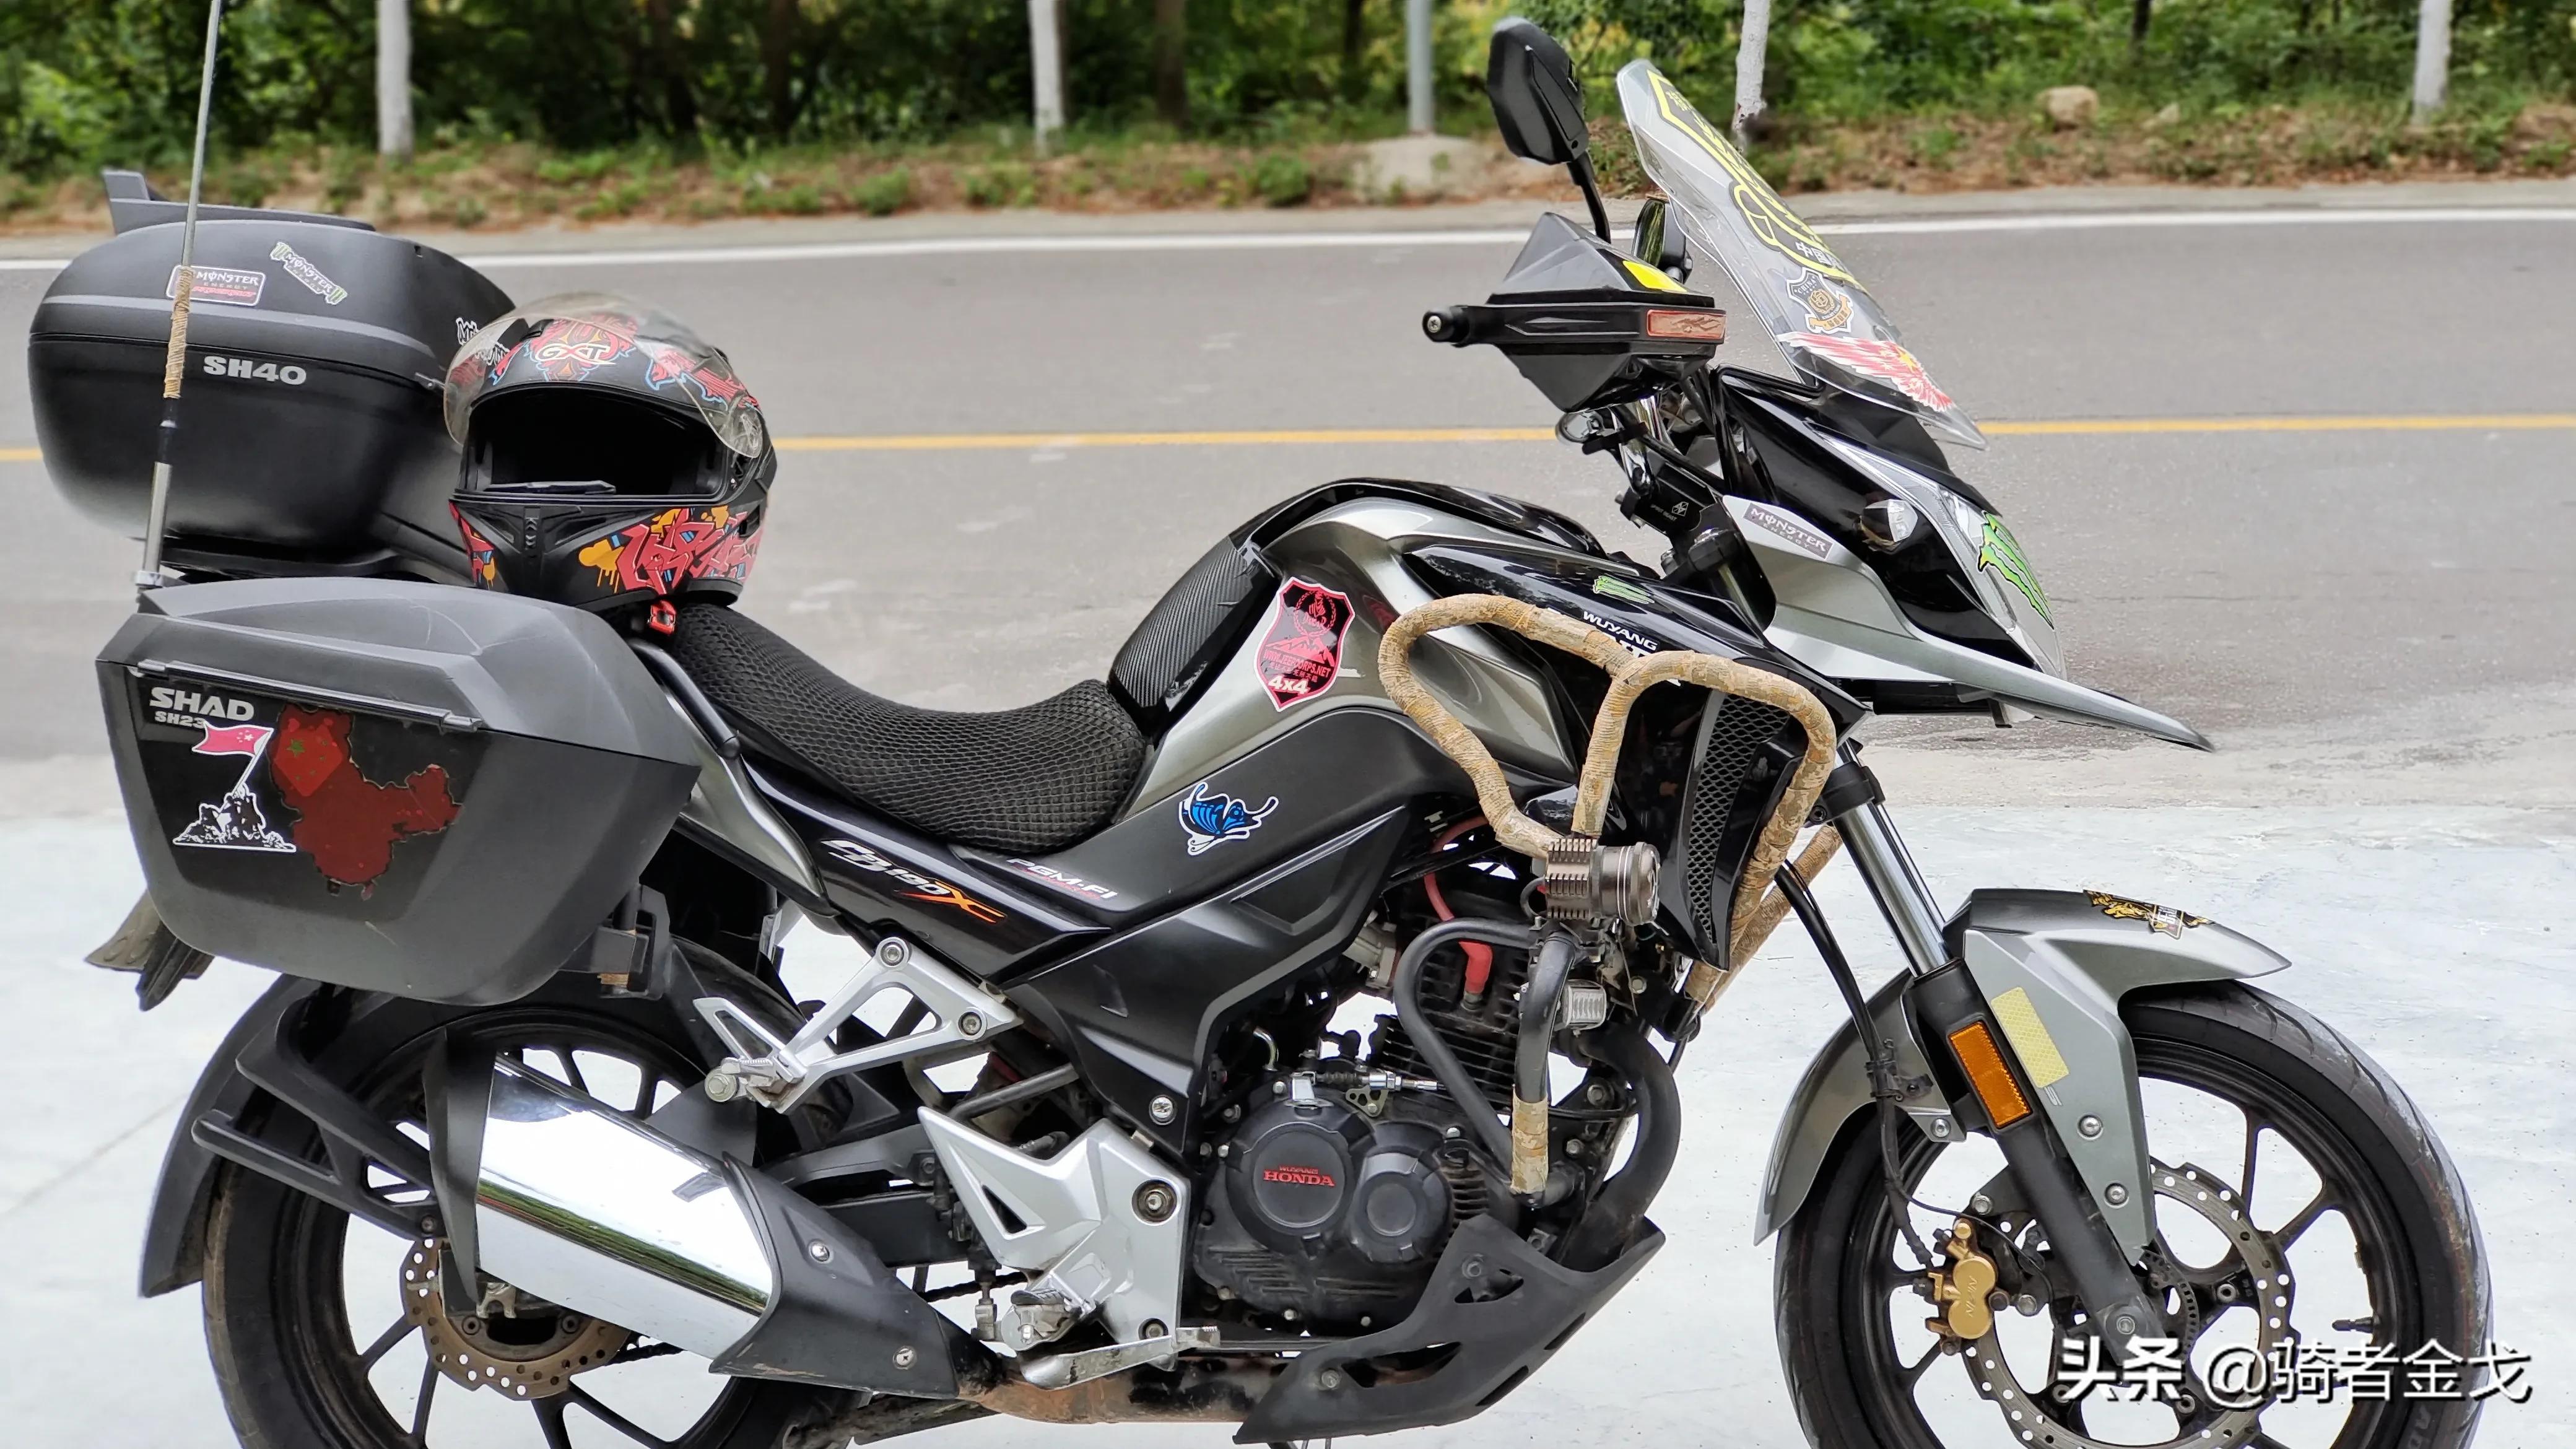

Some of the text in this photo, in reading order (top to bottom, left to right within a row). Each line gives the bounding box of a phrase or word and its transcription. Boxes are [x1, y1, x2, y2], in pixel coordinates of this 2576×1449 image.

[196, 271, 259, 286] MONSTER
[203, 282, 248, 290] ENERGY
[285, 253, 333, 293] MONSTER
[535, 342, 616, 365] GXT
[203, 355, 307, 386] SH40
[1751, 508, 1827, 552] MONSTER
[1763, 524, 1810, 549] ENERGY
[1583, 611, 1658, 651] WUYANG
[149, 687, 255, 721] SHAD
[155, 711, 206, 729] SH23
[1006, 858, 1118, 899] PGM-FI
[1263, 1170, 1335, 1186] HONDA
